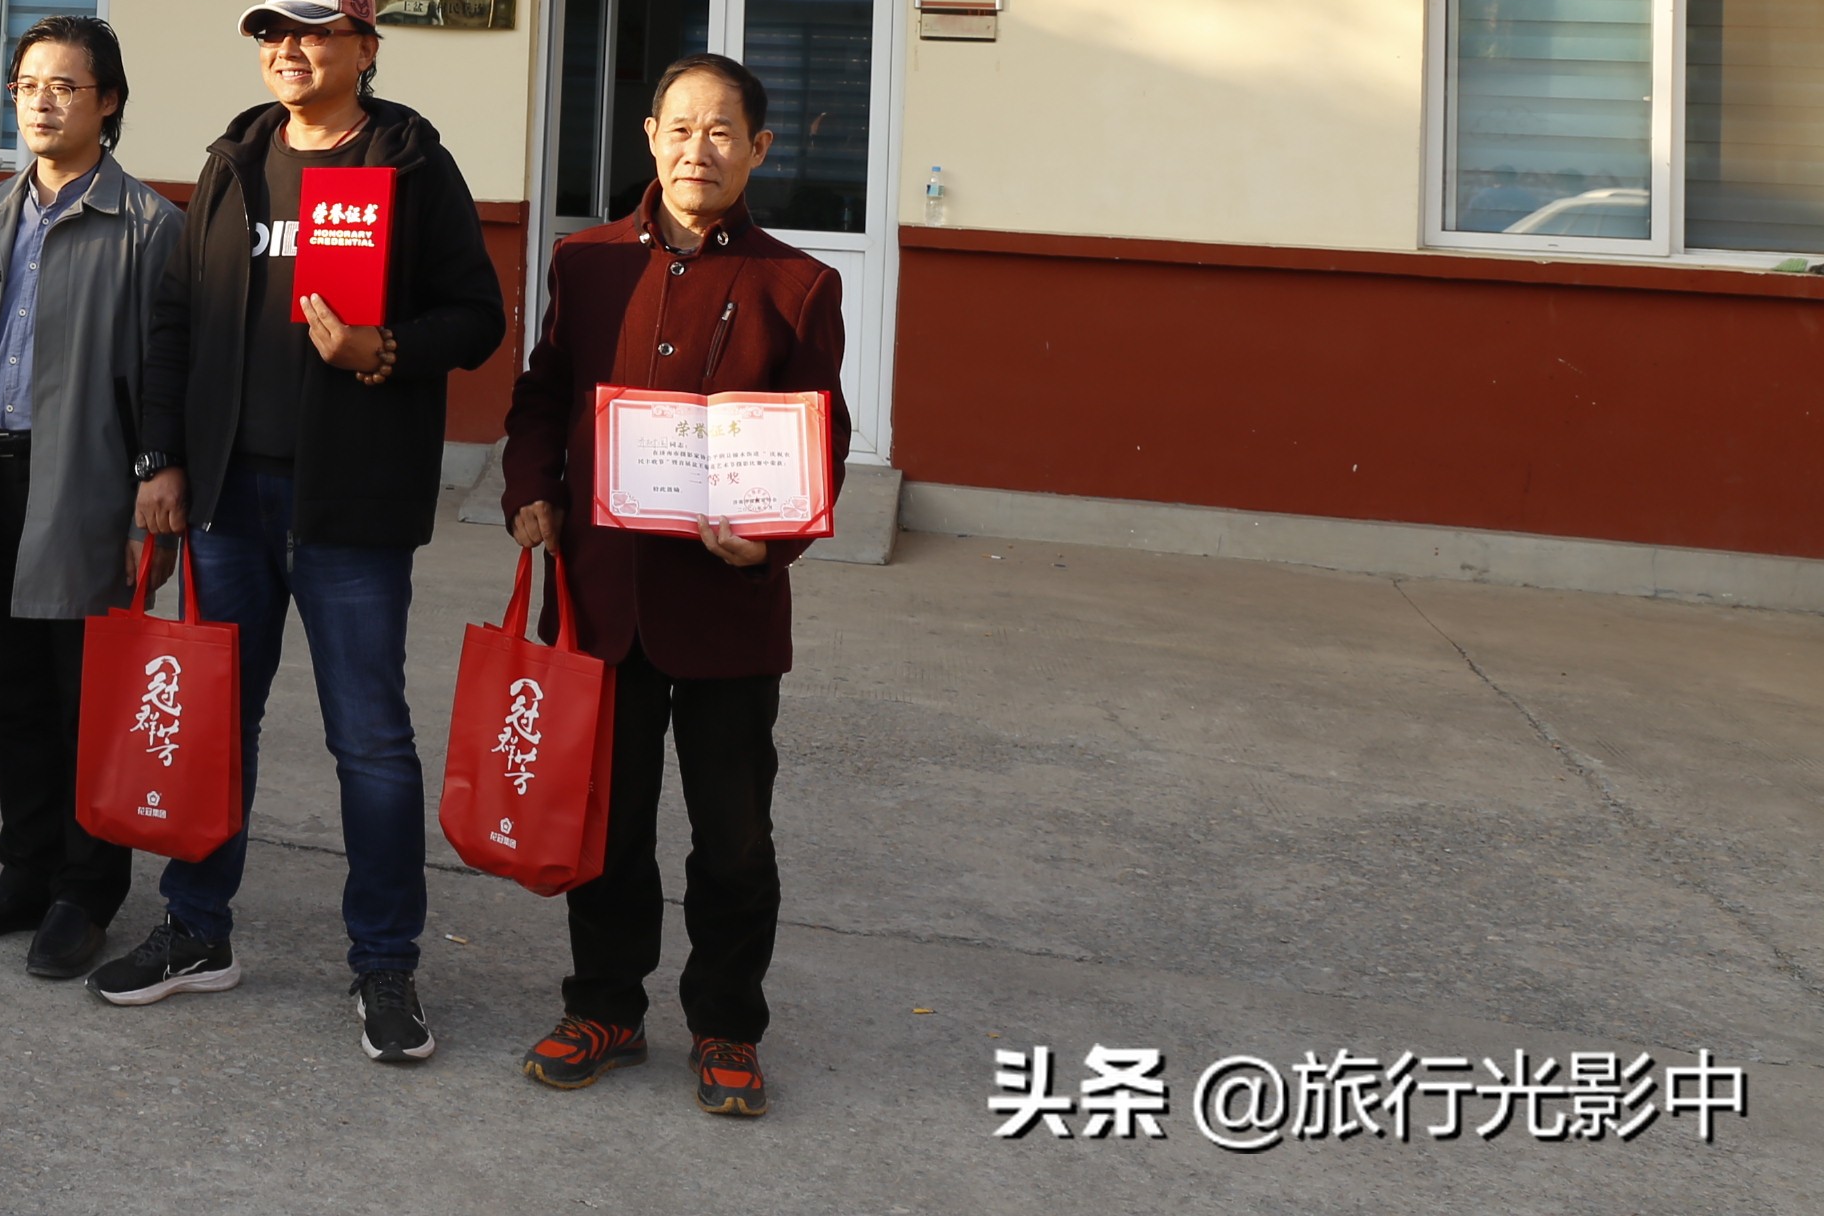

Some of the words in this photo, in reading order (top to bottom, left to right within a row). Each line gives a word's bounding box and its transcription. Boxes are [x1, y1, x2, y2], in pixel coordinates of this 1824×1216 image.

[312, 201, 379, 226] 荣誉证书
[309, 237, 375, 247] CREDENTIAL
[313, 229, 372, 238] HONORARY
[675, 419, 742, 440] 荣誉证书
[129, 655, 183, 767] 冠群芳
[490, 677, 544, 796] 冠群芳
